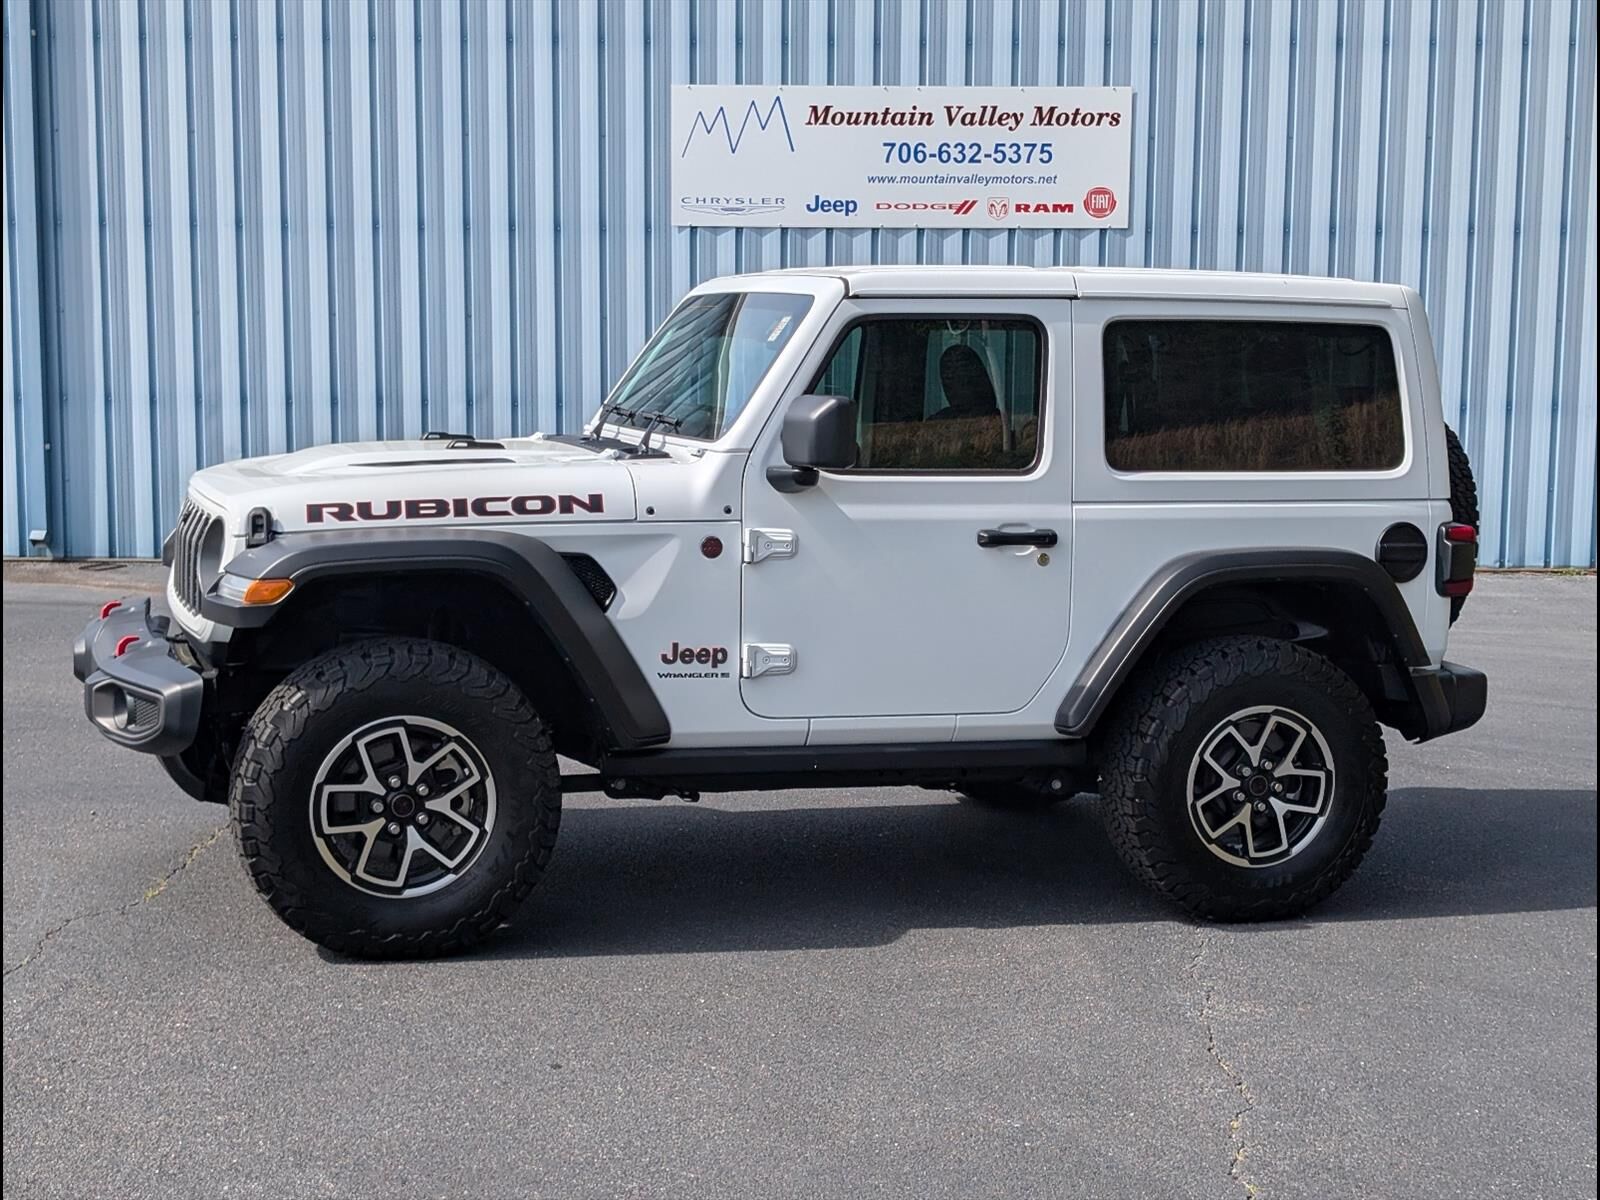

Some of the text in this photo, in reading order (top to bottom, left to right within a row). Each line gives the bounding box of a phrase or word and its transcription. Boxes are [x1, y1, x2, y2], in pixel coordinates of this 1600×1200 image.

[805, 105, 1121, 131] Mountain Valley Motors
[882, 142, 1053, 164] 706-632-5375
[867, 173, 1058, 187] www.mountainvalleymotors.net
[681, 196, 785, 205] CHRYSLER
[806, 195, 858, 216] Jeep
[1015, 203, 1074, 213] RAM
[1091, 194, 1110, 209] FIAT
[305, 493, 606, 523] RUBICON
[661, 642, 728, 668] Jeep
